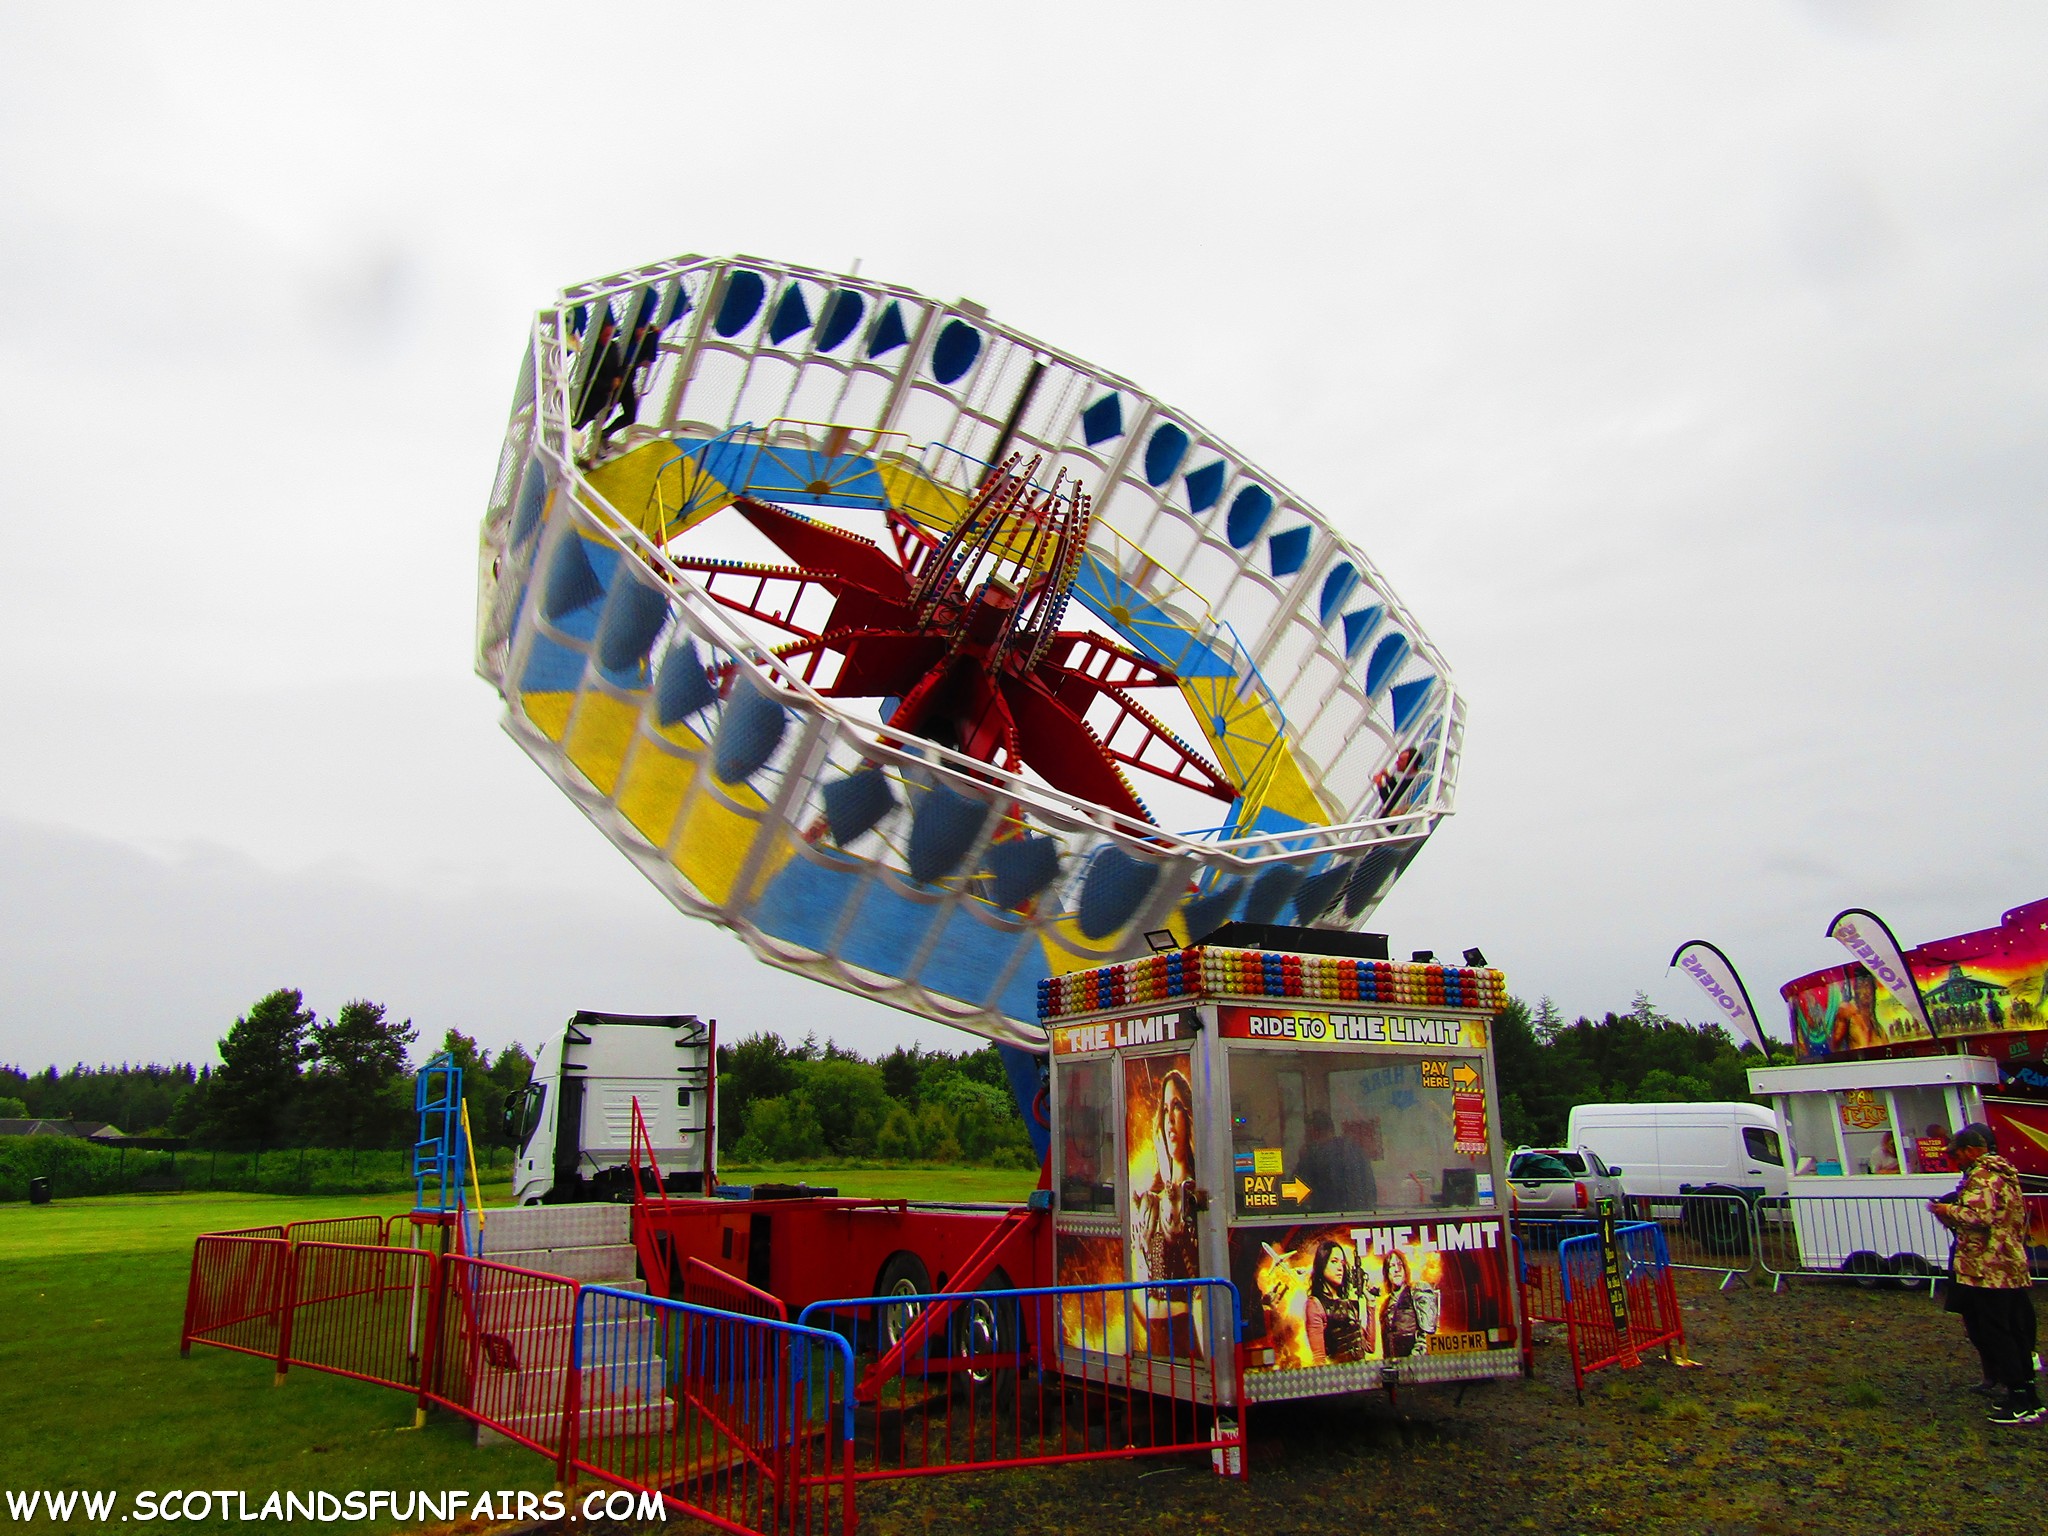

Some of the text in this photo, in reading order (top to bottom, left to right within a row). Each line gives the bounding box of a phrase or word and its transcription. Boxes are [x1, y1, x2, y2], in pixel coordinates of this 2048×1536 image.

[1068, 1013, 1180, 1052] THE LIMIT
[1250, 1014, 1460, 1044] RIDE TO THE LIMIT
[1421, 1060, 1448, 1076] PAY
[1422, 1077, 1450, 1088] HERE
[1243, 1176, 1276, 1193] PAY
[1244, 1193, 1279, 1206] HERE
[1350, 1221, 1500, 1257] THE LIMIT
[1429, 1333, 1483, 1351] FN09 FWR
